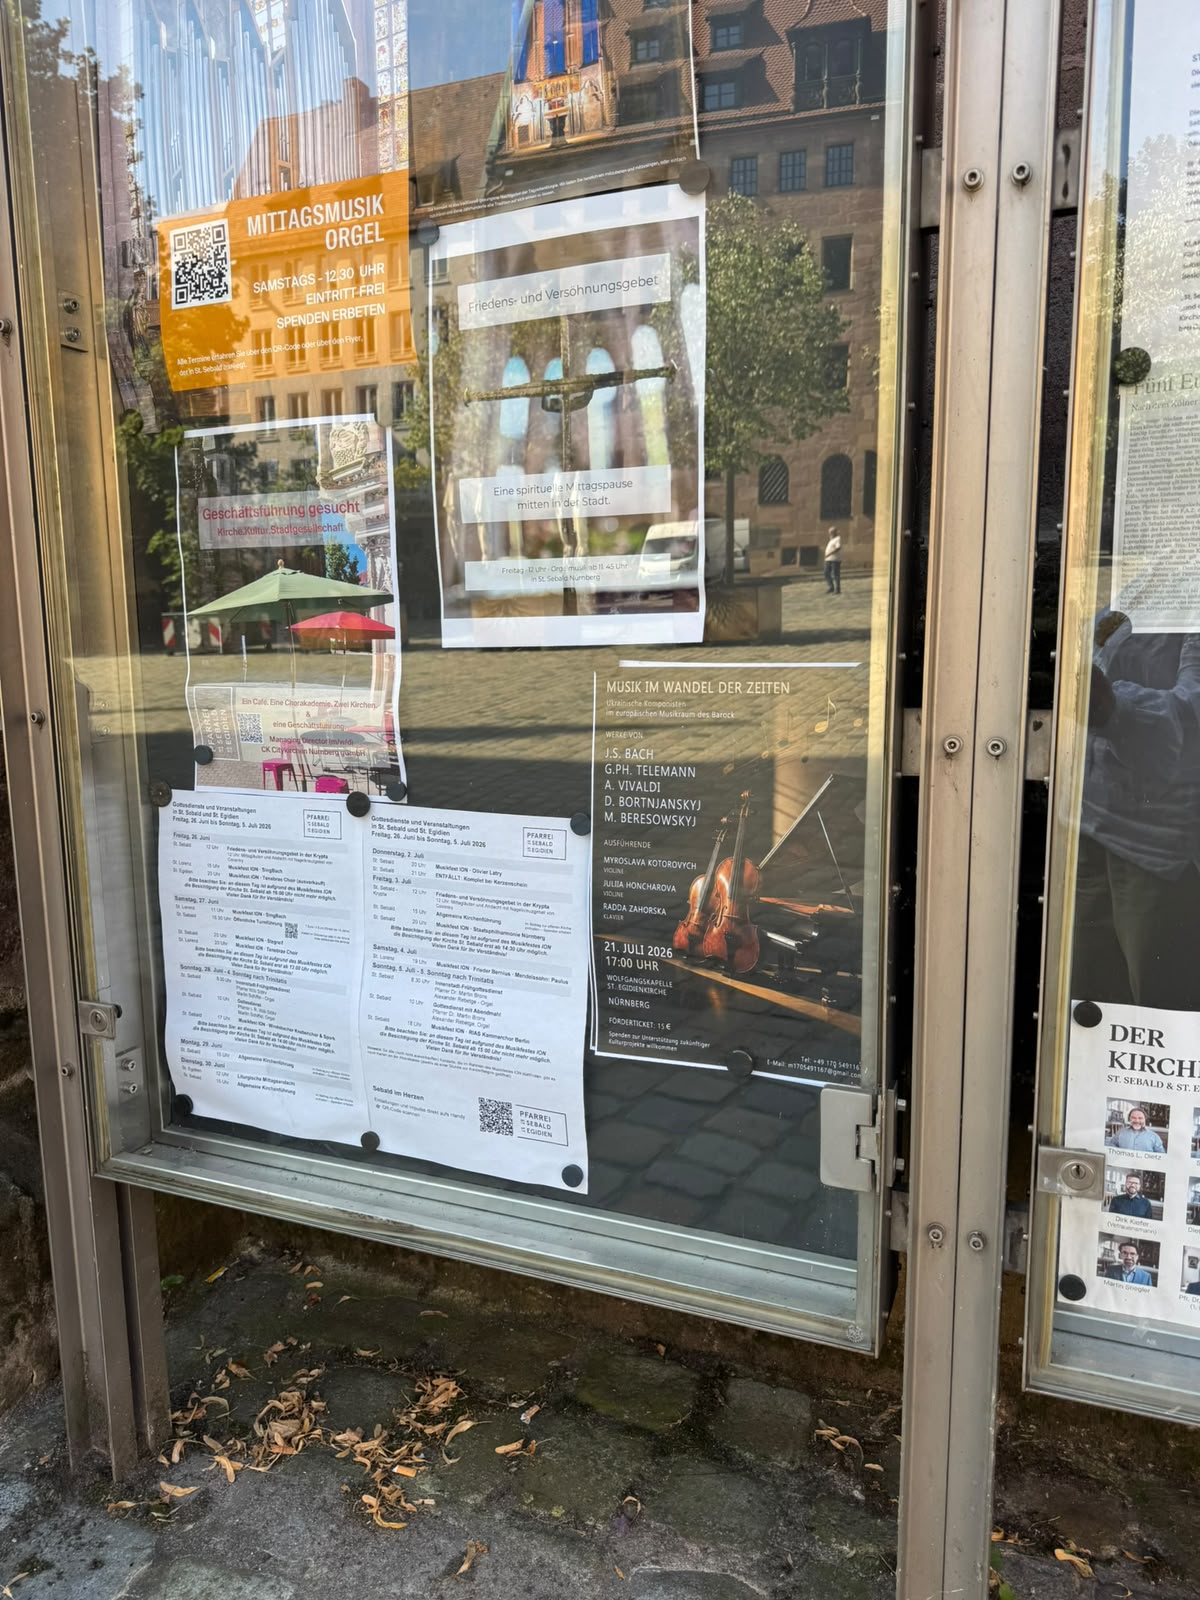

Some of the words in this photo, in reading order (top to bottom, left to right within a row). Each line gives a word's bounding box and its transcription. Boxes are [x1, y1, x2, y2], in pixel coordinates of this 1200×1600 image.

[247, 193, 384, 237] MITTAGSMUSIK
[325, 222, 385, 250] ORGEL
[253, 273, 315, 294] SAMSTAGS
[325, 267, 354, 283] 12.30
[359, 262, 385, 277] UHR
[306, 287, 356, 305] EINTRITT
[359, 282, 385, 298] FREI
[468, 297, 518, 313] Friedens-
[520, 290, 543, 305] und
[545, 275, 659, 300] Versöhnungsgebet
[276, 312, 330, 329] SPENDEN
[332, 303, 385, 322] ERBETEN
[494, 487, 514, 497] Eine
[566, 480, 633, 493] Mttagspause
[203, 504, 305, 520] Geschäftsführung
[308, 500, 360, 518] gesucht
[518, 500, 549, 510] mitten
[564, 498, 579, 507] der
[582, 496, 611, 506] Stadt.
[502, 567, 524, 575] Freitag
[607, 681, 642, 693] MUSIK
[645, 681, 659, 693] IM
[663, 681, 713, 694] WANDEL
[719, 681, 742, 694] DER
[746, 681, 790, 694] ZEITEN
[629, 731, 643, 739] VON
[605, 748, 621, 759] J.S.
[625, 748, 654, 760] BACH
[604, 763, 632, 775] G.PH.
[636, 765, 696, 778] TELEMANN
[604, 780, 614, 790] A.
[618, 781, 661, 792] VIVALDI
[605, 795, 614, 807] D.
[619, 796, 701, 811] BORTNJANSKYJ
[371, 815, 409, 824] Gottesdienste
[423, 820, 470, 831] Veranstaltungen
[604, 811, 616, 822] M.
[621, 812, 696, 827] BERESOWSKYJ
[387, 824, 406, 832] Sebald
[371, 831, 392, 839] Freitag,
[426, 836, 452, 845] Sonntag,
[604, 839, 651, 849] AUSFÜHRENDE
[372, 848, 406, 857] Donnerstag,
[603, 856, 646, 866] MYROSLAVA
[648, 859, 697, 870] KOTOROVYCH
[626, 882, 676, 892] HONCHAROVA
[603, 903, 627, 912] RADDA
[629, 905, 667, 915] ZAHORSKA
[604, 941, 619, 952] 21.
[623, 944, 644, 955] JULI
[647, 946, 673, 958] 2026
[606, 956, 633, 968] 17:00
[636, 960, 659, 971] UHR
[606, 974, 673, 988] WOLFGANGSKAPELLE
[618, 984, 667, 995] EGIDIENKIRCHE
[608, 996, 650, 1009] NÜRNBERG
[609, 1017, 656, 1028] FÖRDERTICKET:
[642, 1035, 678, 1045] Unterstützung
[1109, 1024, 1165, 1048] DER
[609, 1039, 645, 1048] Kulturprojekte
[1108, 1050, 1200, 1079] KIRCH
[1107, 1074, 1121, 1083] ST.
[1123, 1076, 1164, 1088] SEBALD
[1166, 1082, 1174, 1090] &
[1176, 1083, 1190, 1092] ST.
[372, 1085, 393, 1095] Sebald
[403, 1091, 425, 1101] Herzen
[520, 1111, 551, 1122] PFARREI
[526, 1119, 551, 1130] SEBALD
[527, 1127, 553, 1137] EGIDIEN
[1108, 1148, 1135, 1158] Thomas
[1136, 1151, 1142, 1159] L.
[1144, 1152, 1162, 1160] Dietz
[1115, 1215, 1128, 1223] Dirk
[1130, 1218, 1149, 1227] Kiefer
[1103, 1279, 1125, 1289] Martin
